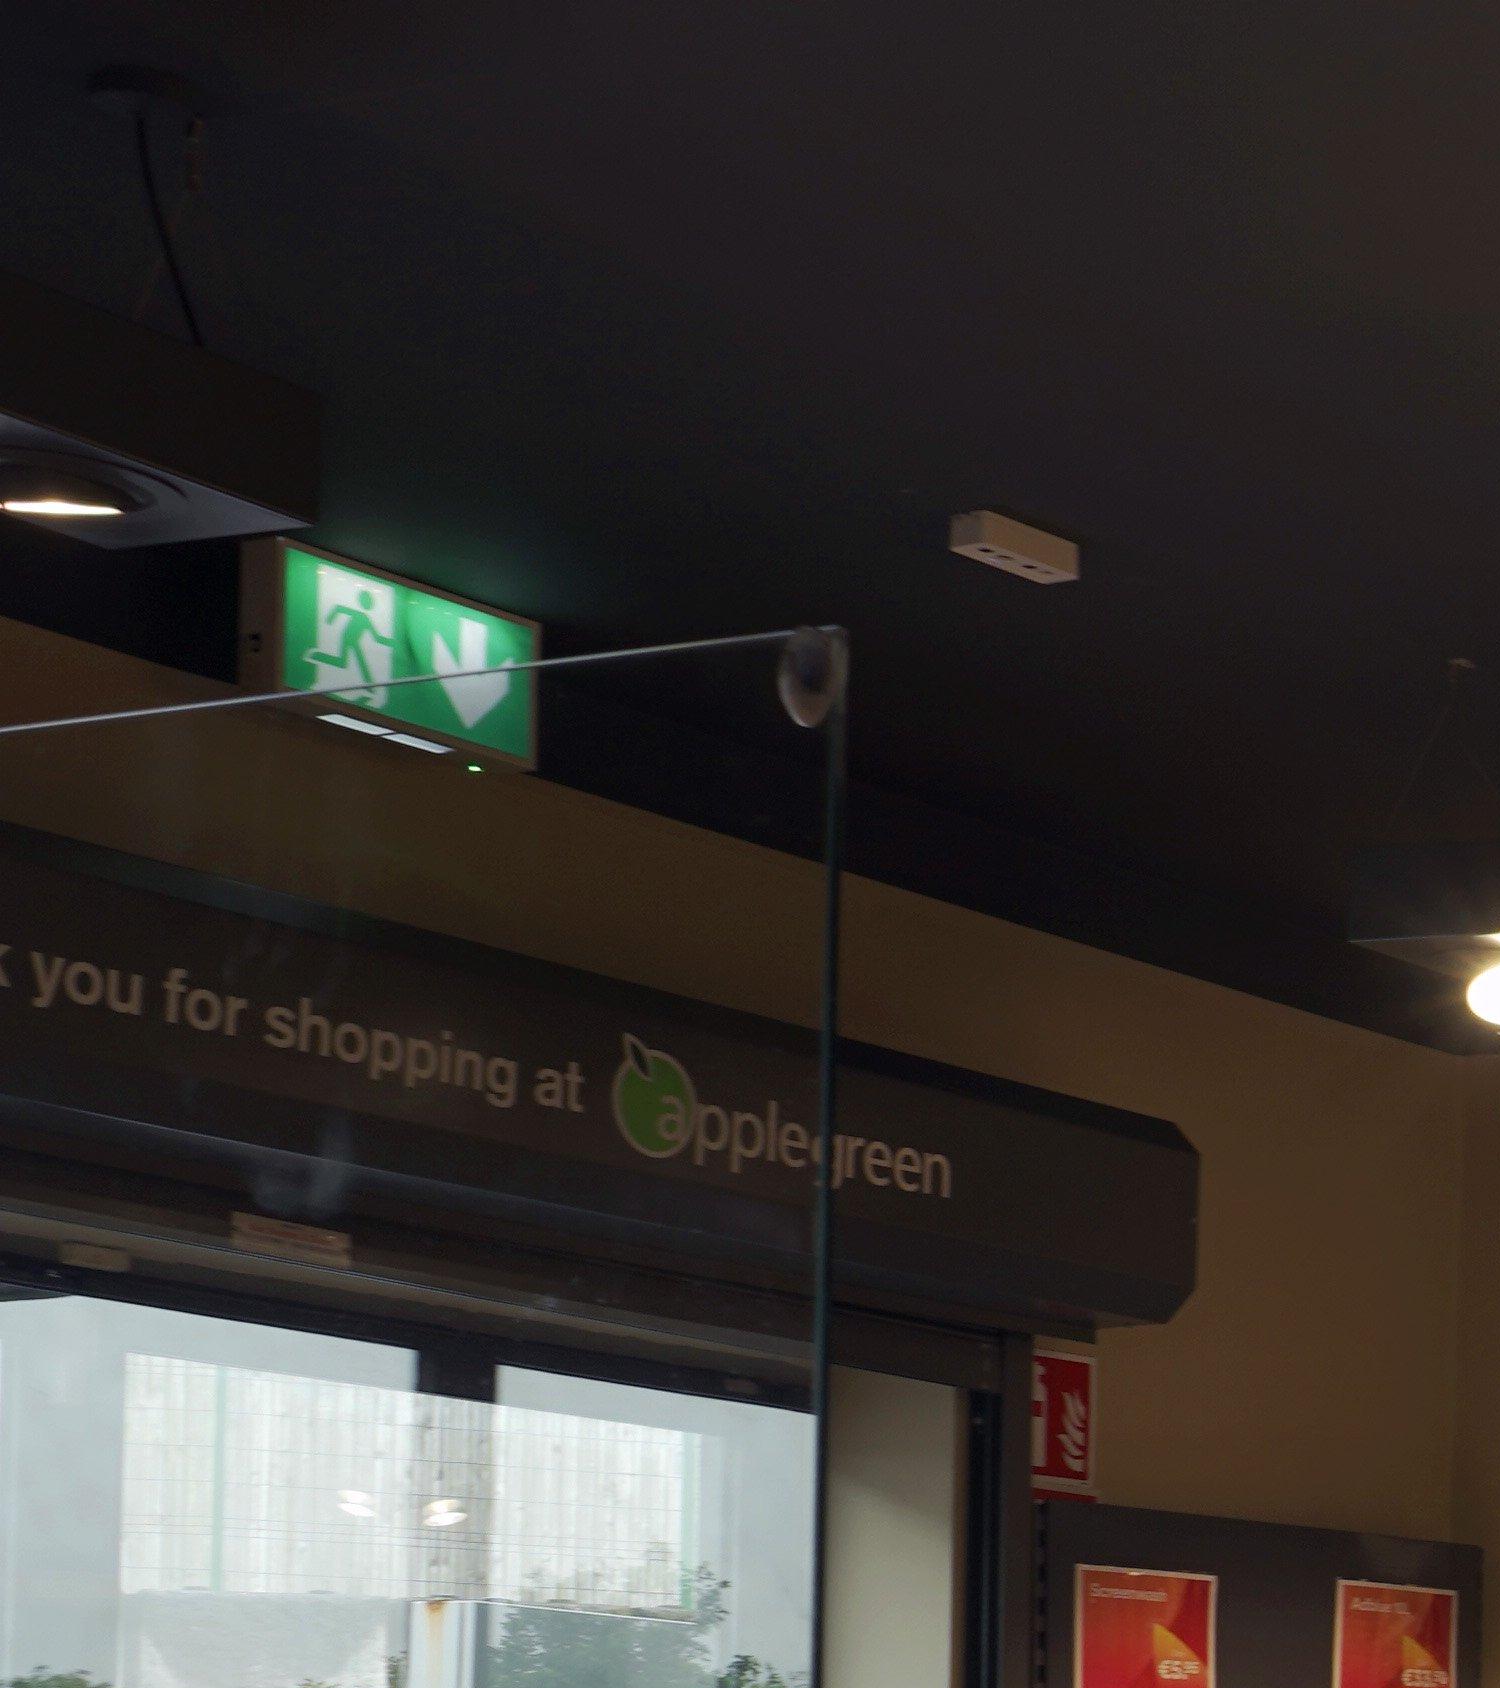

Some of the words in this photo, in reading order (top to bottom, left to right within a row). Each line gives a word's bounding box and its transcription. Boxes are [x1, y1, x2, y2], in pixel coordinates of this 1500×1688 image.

[30, 950, 145, 1016] you
[163, 967, 248, 1036] for
[263, 996, 518, 1109] shopping
[532, 1060, 585, 1112] at
[656, 1096, 952, 1199] applegreen
